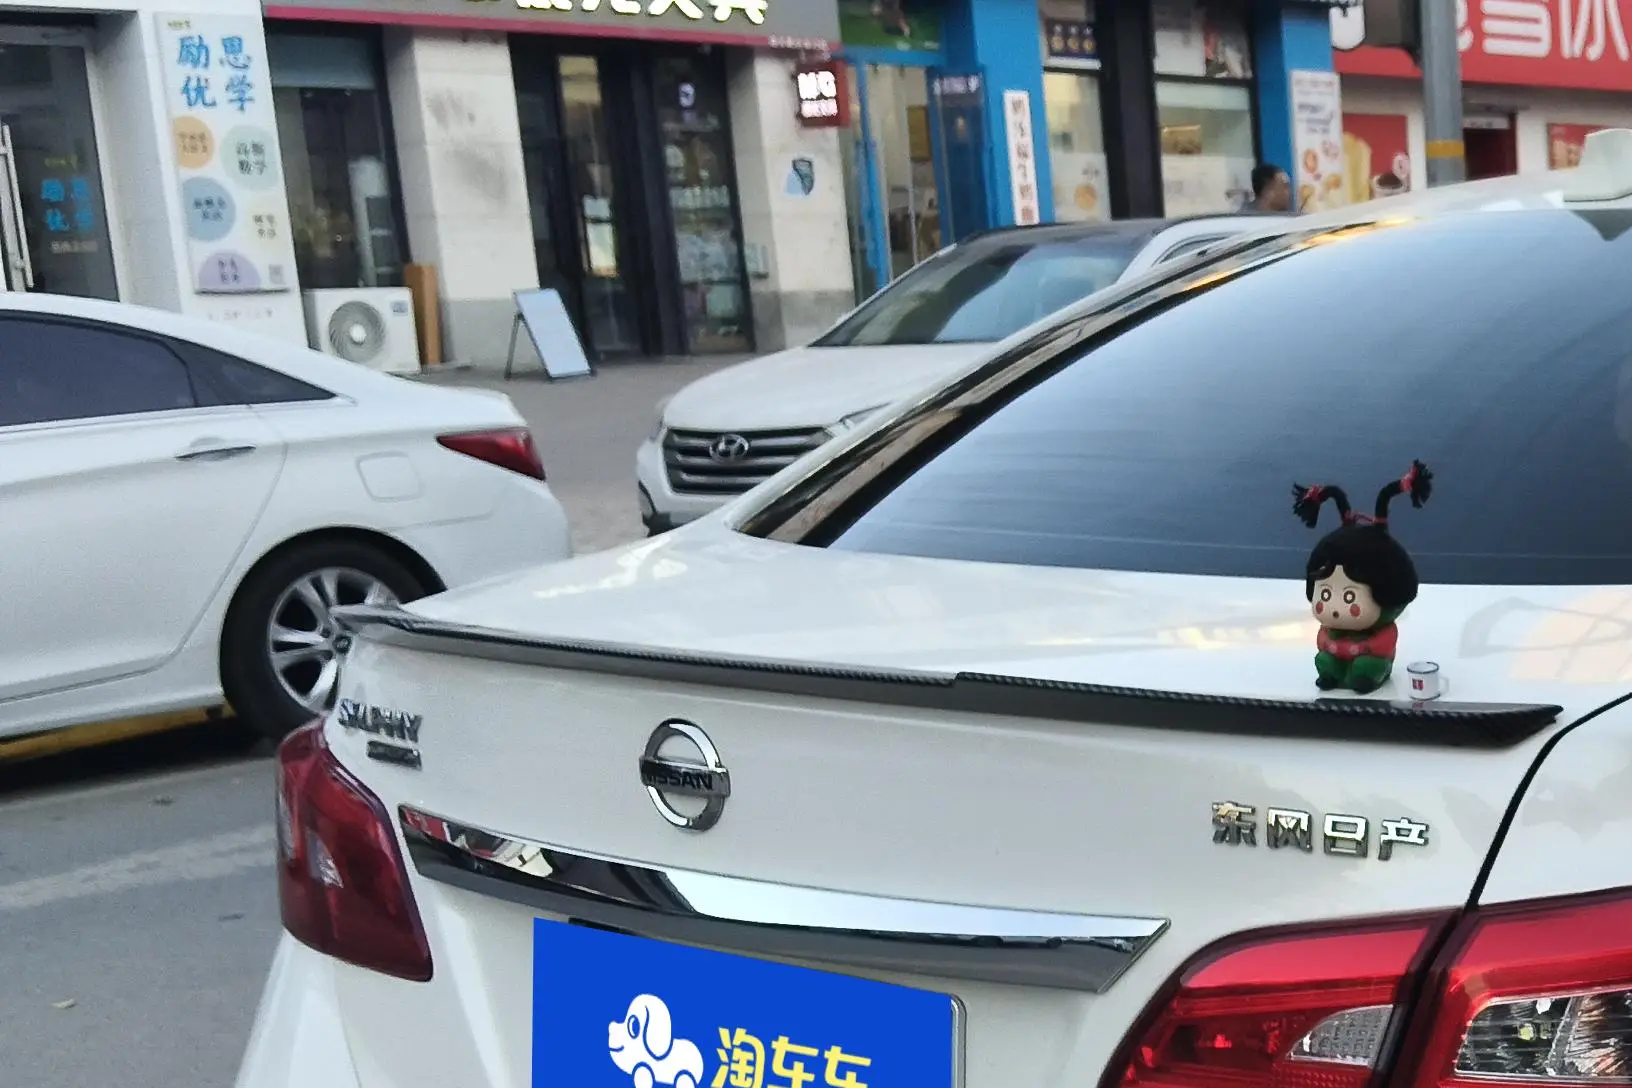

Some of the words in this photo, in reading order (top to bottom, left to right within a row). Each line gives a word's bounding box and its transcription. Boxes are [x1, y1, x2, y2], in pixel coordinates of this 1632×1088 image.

[177, 34, 253, 69] 励思
[180, 74, 256, 112] 优学
[1211, 800, 1430, 861] 东风日产
